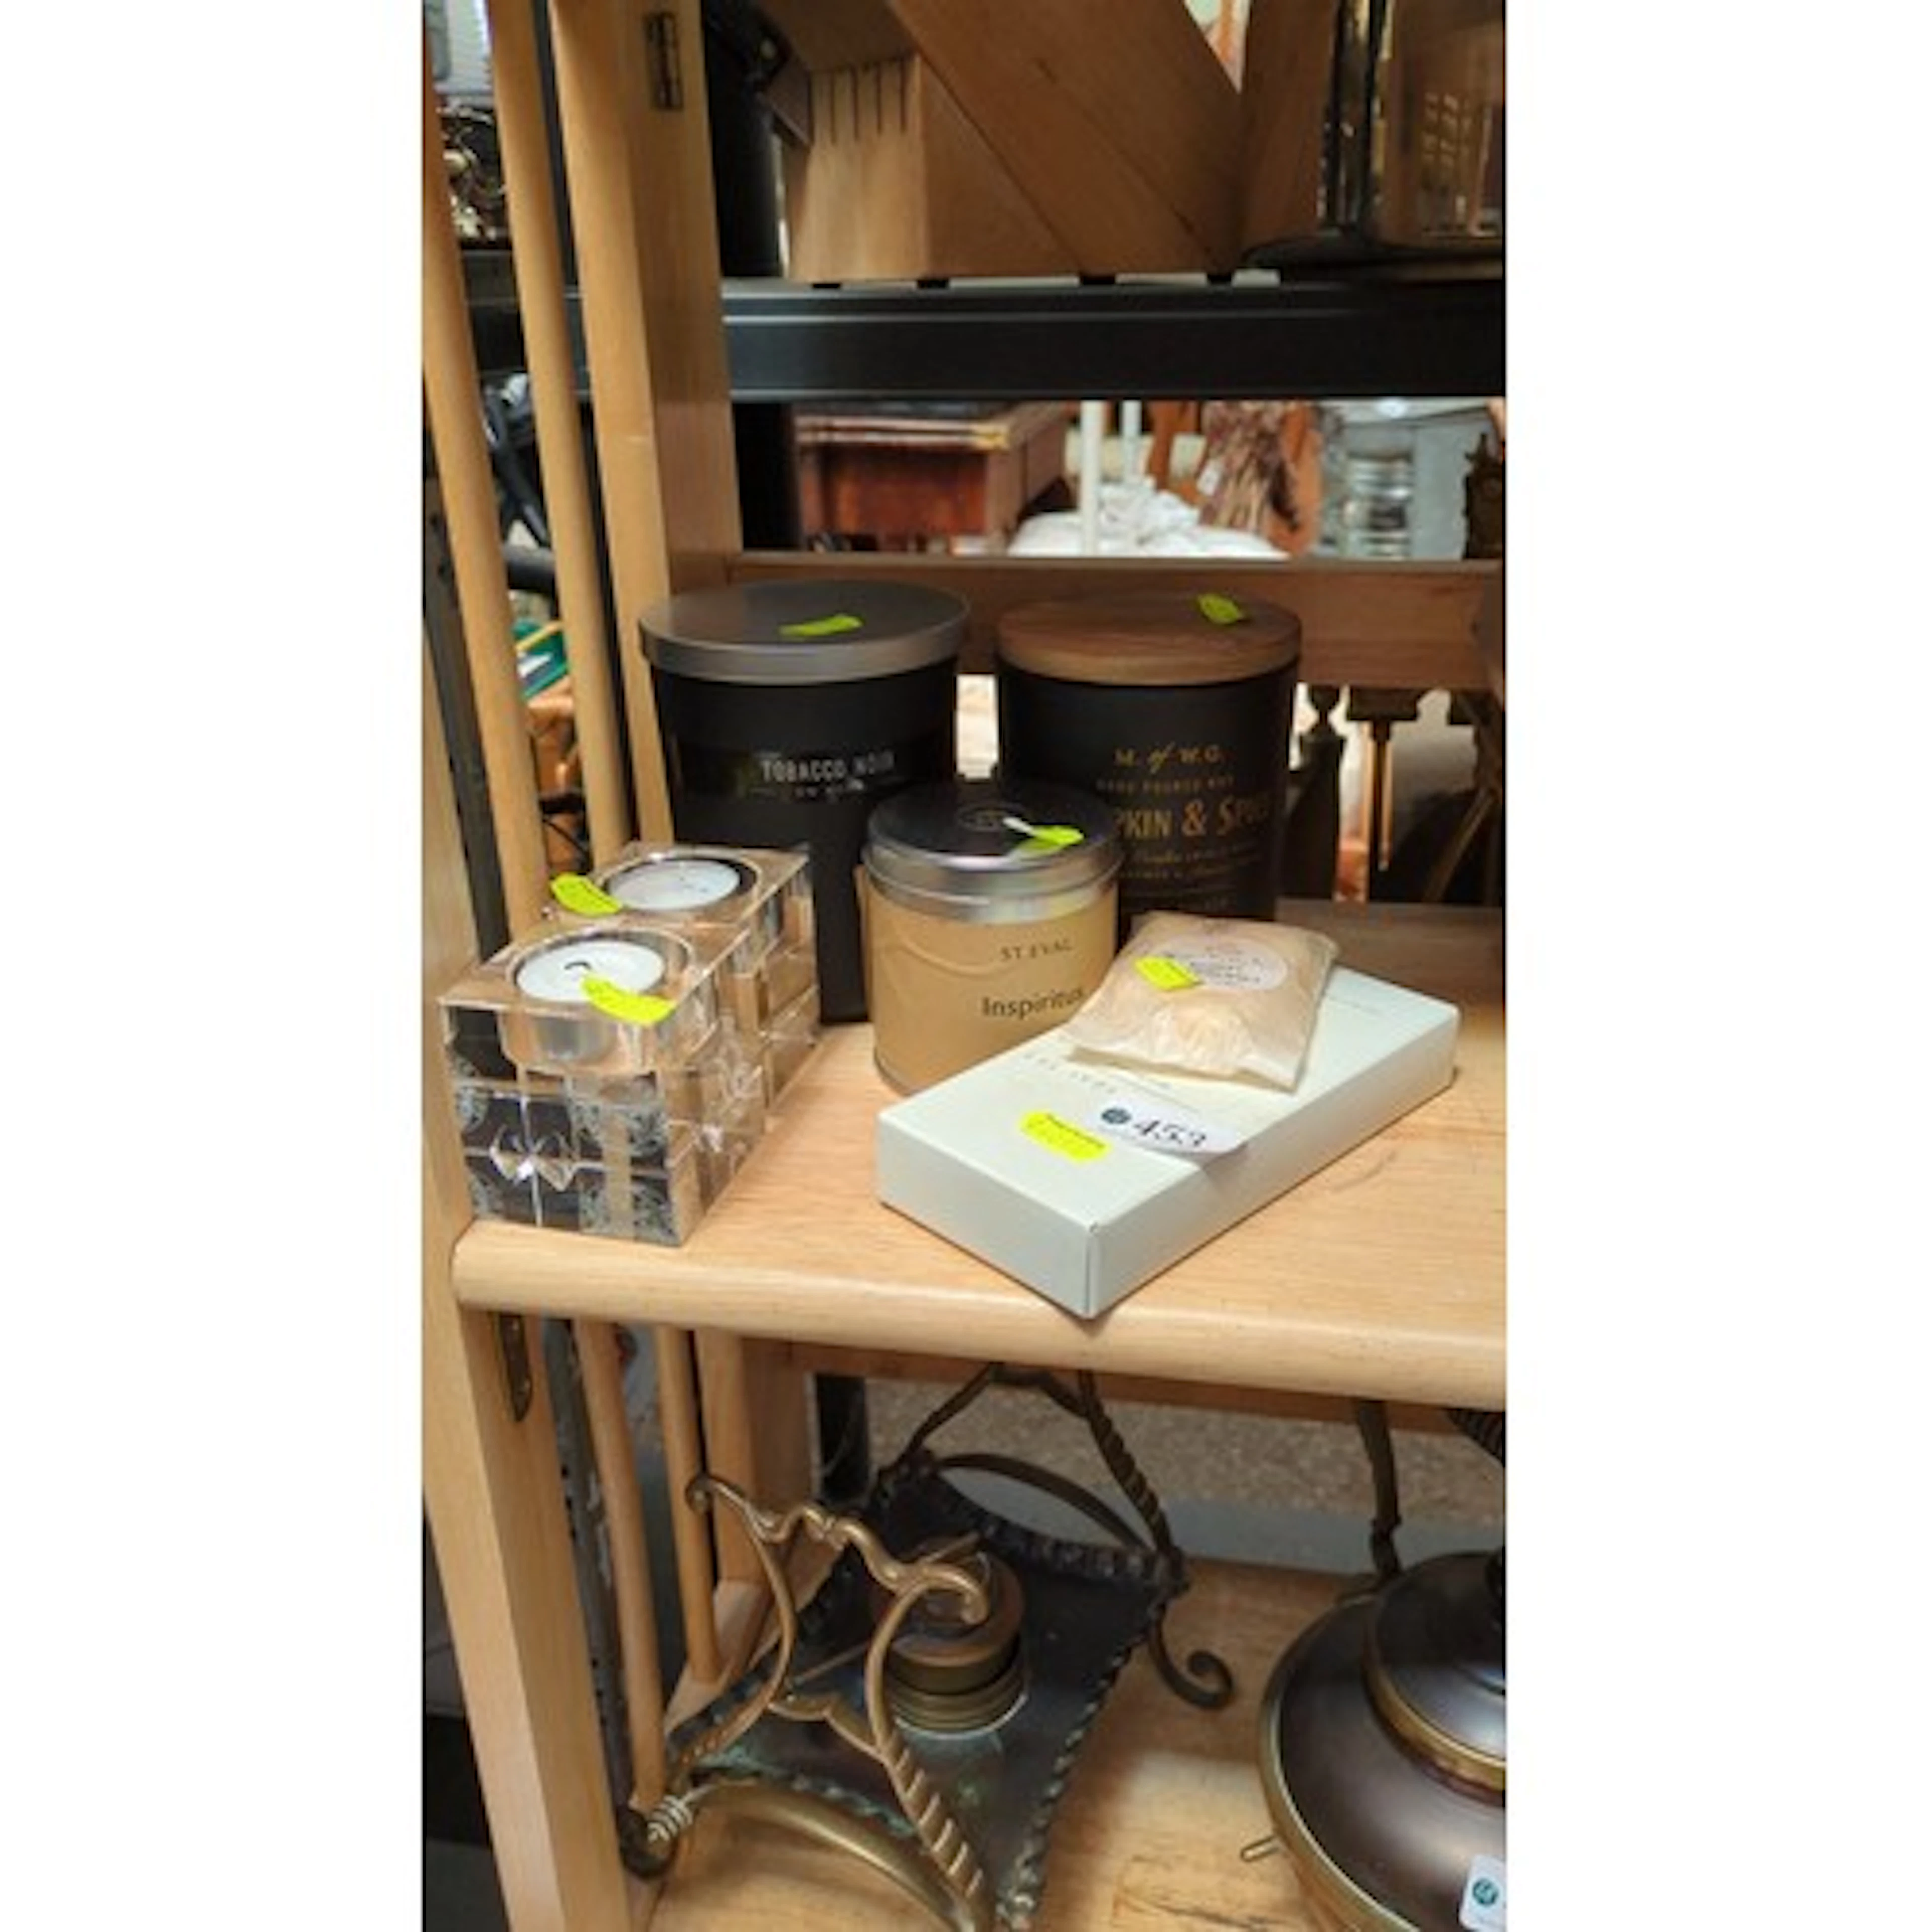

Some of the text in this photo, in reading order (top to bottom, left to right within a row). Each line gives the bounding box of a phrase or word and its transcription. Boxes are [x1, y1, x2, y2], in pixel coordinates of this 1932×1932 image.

[761, 758, 847, 784] TOBACCO
[1181, 798, 1208, 837] &
[1134, 1118, 1208, 1148] 453
